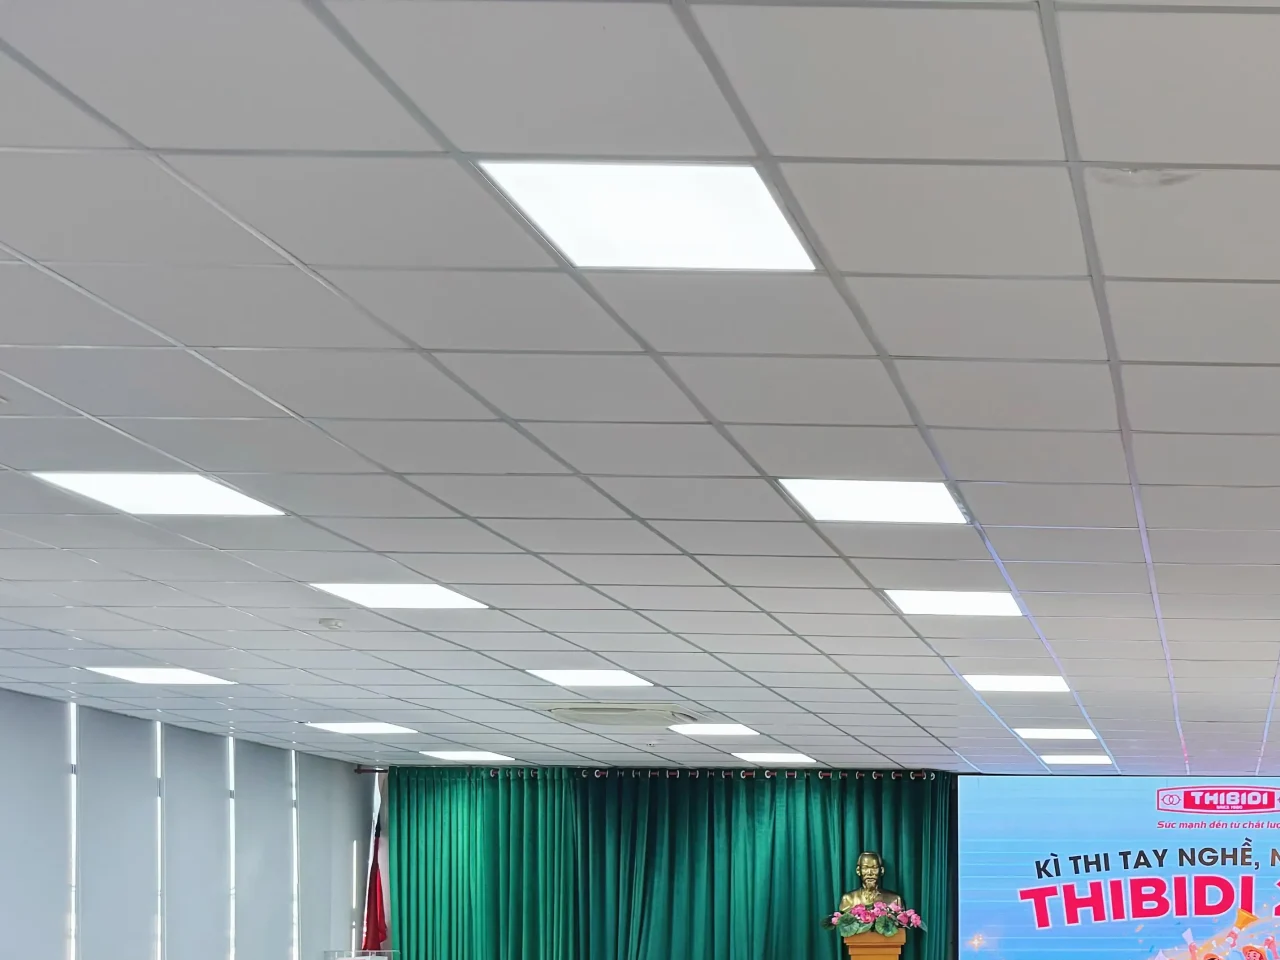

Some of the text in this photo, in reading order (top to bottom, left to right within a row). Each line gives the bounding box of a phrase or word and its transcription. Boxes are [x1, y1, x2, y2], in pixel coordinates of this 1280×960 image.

[1190, 791, 1268, 805] THIBIDI
[1179, 820, 1207, 830] mạnh
[1035, 853, 1062, 879] KÌ
[1069, 852, 1110, 875] THI
[1119, 849, 1168, 870] TAY
[1178, 837, 1260, 870] NGHỀ,
[1018, 874, 1254, 929] THIBIDI
